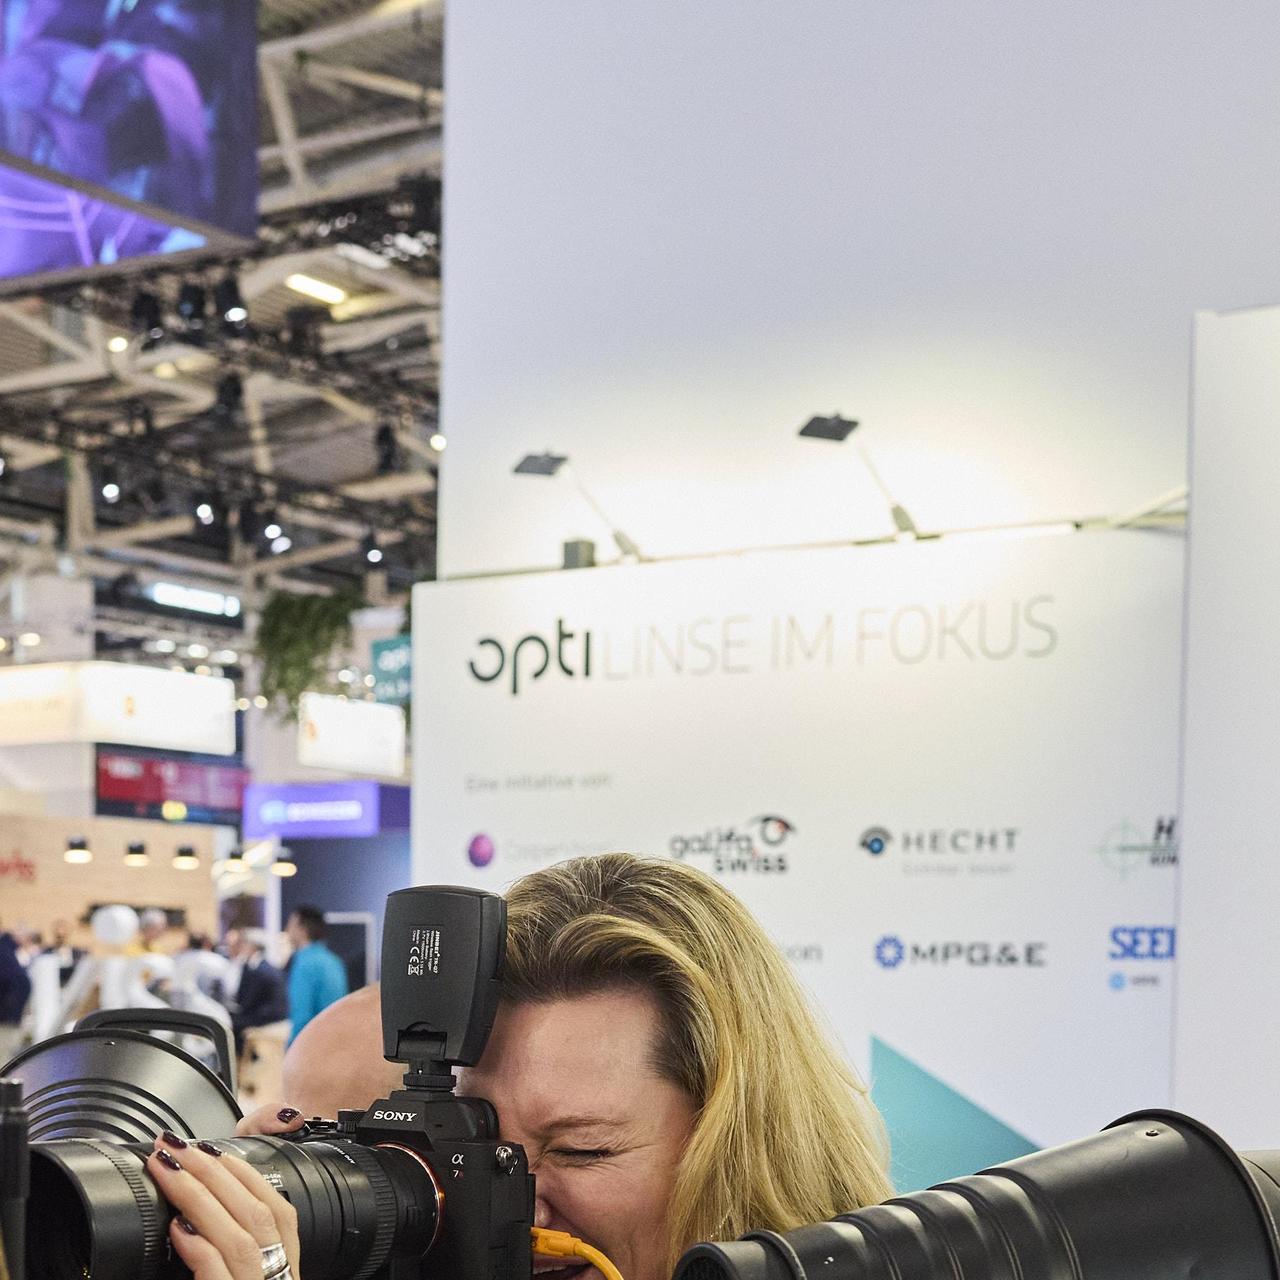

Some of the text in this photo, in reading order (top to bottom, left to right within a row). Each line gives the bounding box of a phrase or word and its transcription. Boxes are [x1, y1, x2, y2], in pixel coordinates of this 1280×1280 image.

[466, 594, 1060, 696] opti LINSE IM FOKUS
[902, 827, 1021, 855] HECHT
[373, 1110, 417, 1122] SONY
